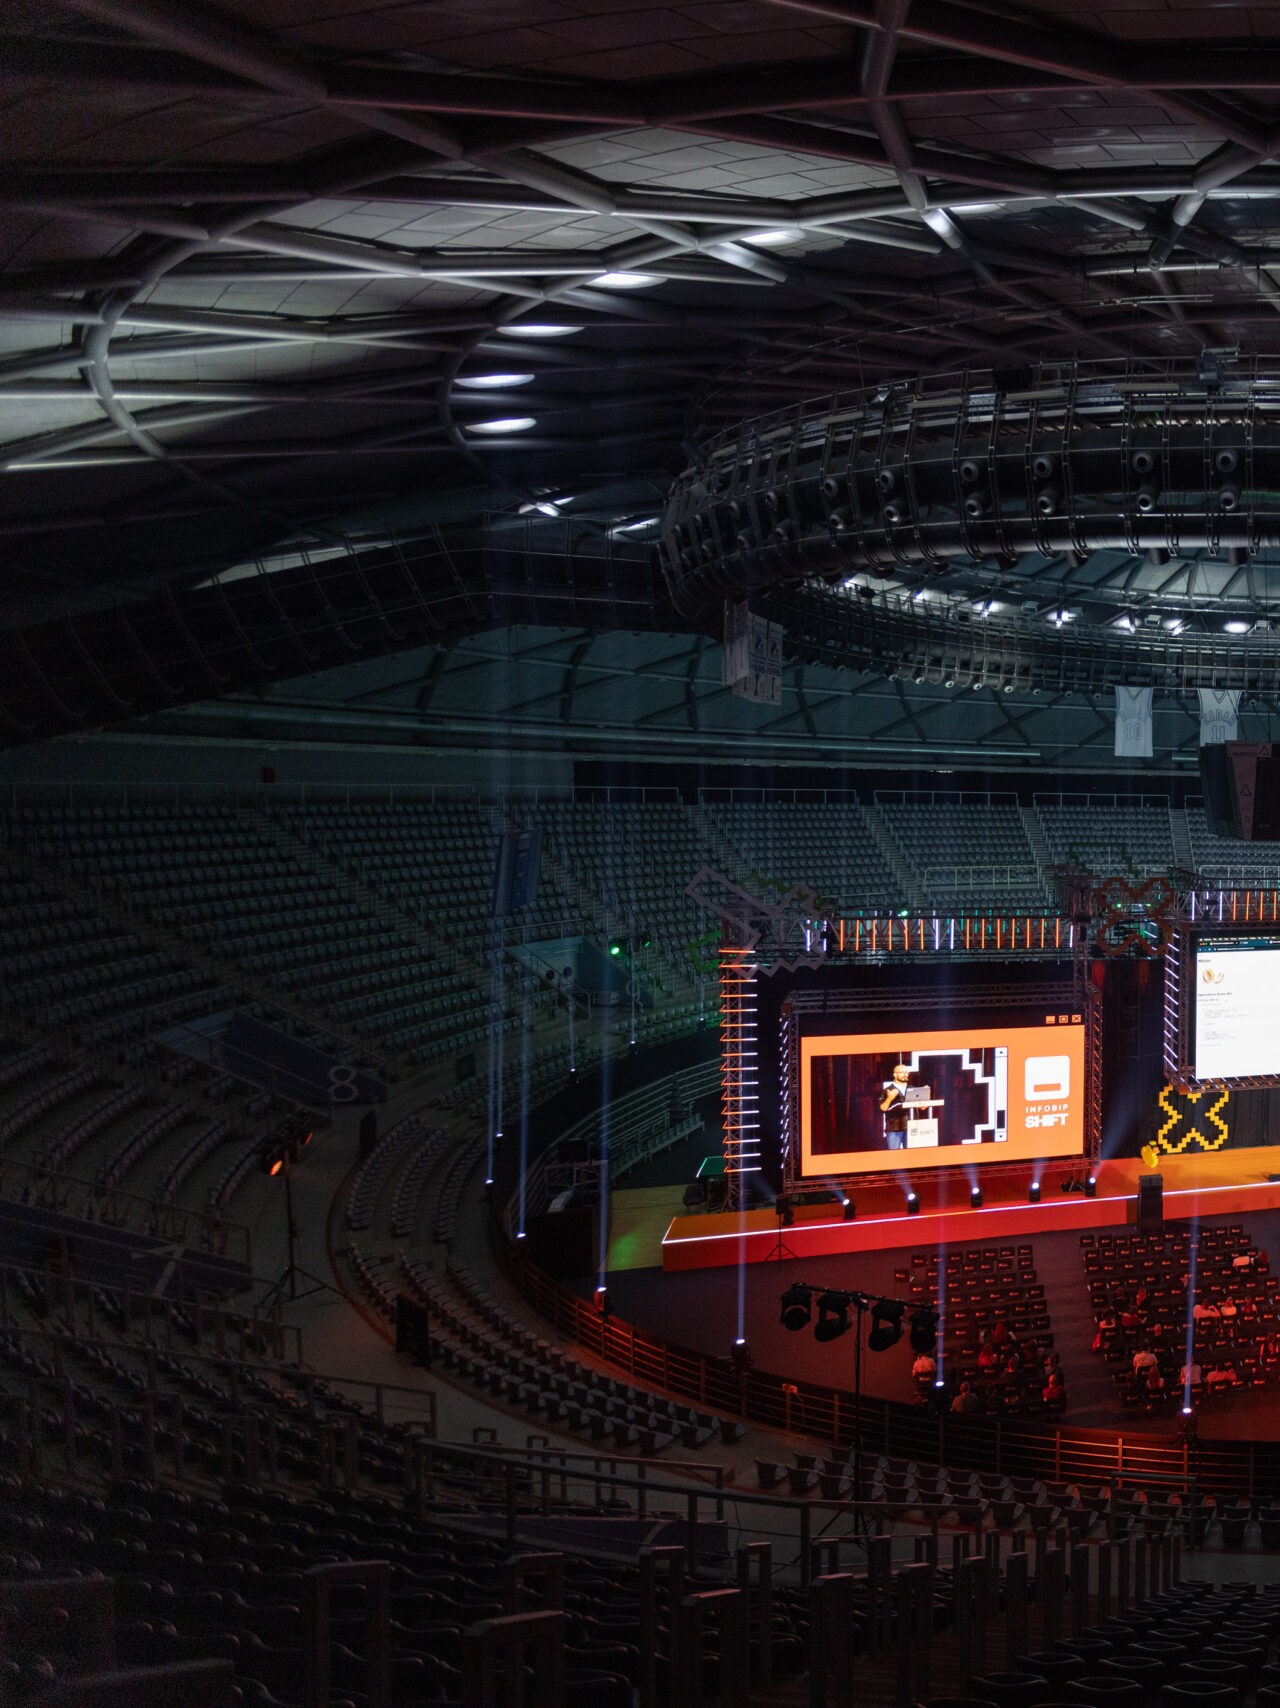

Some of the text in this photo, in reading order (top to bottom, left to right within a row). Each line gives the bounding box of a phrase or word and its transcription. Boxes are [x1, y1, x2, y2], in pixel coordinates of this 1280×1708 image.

[328, 1064, 359, 1102] 8
[1025, 1103, 1069, 1113] INFOBIP
[1025, 1113, 1069, 1128] SHIFT
